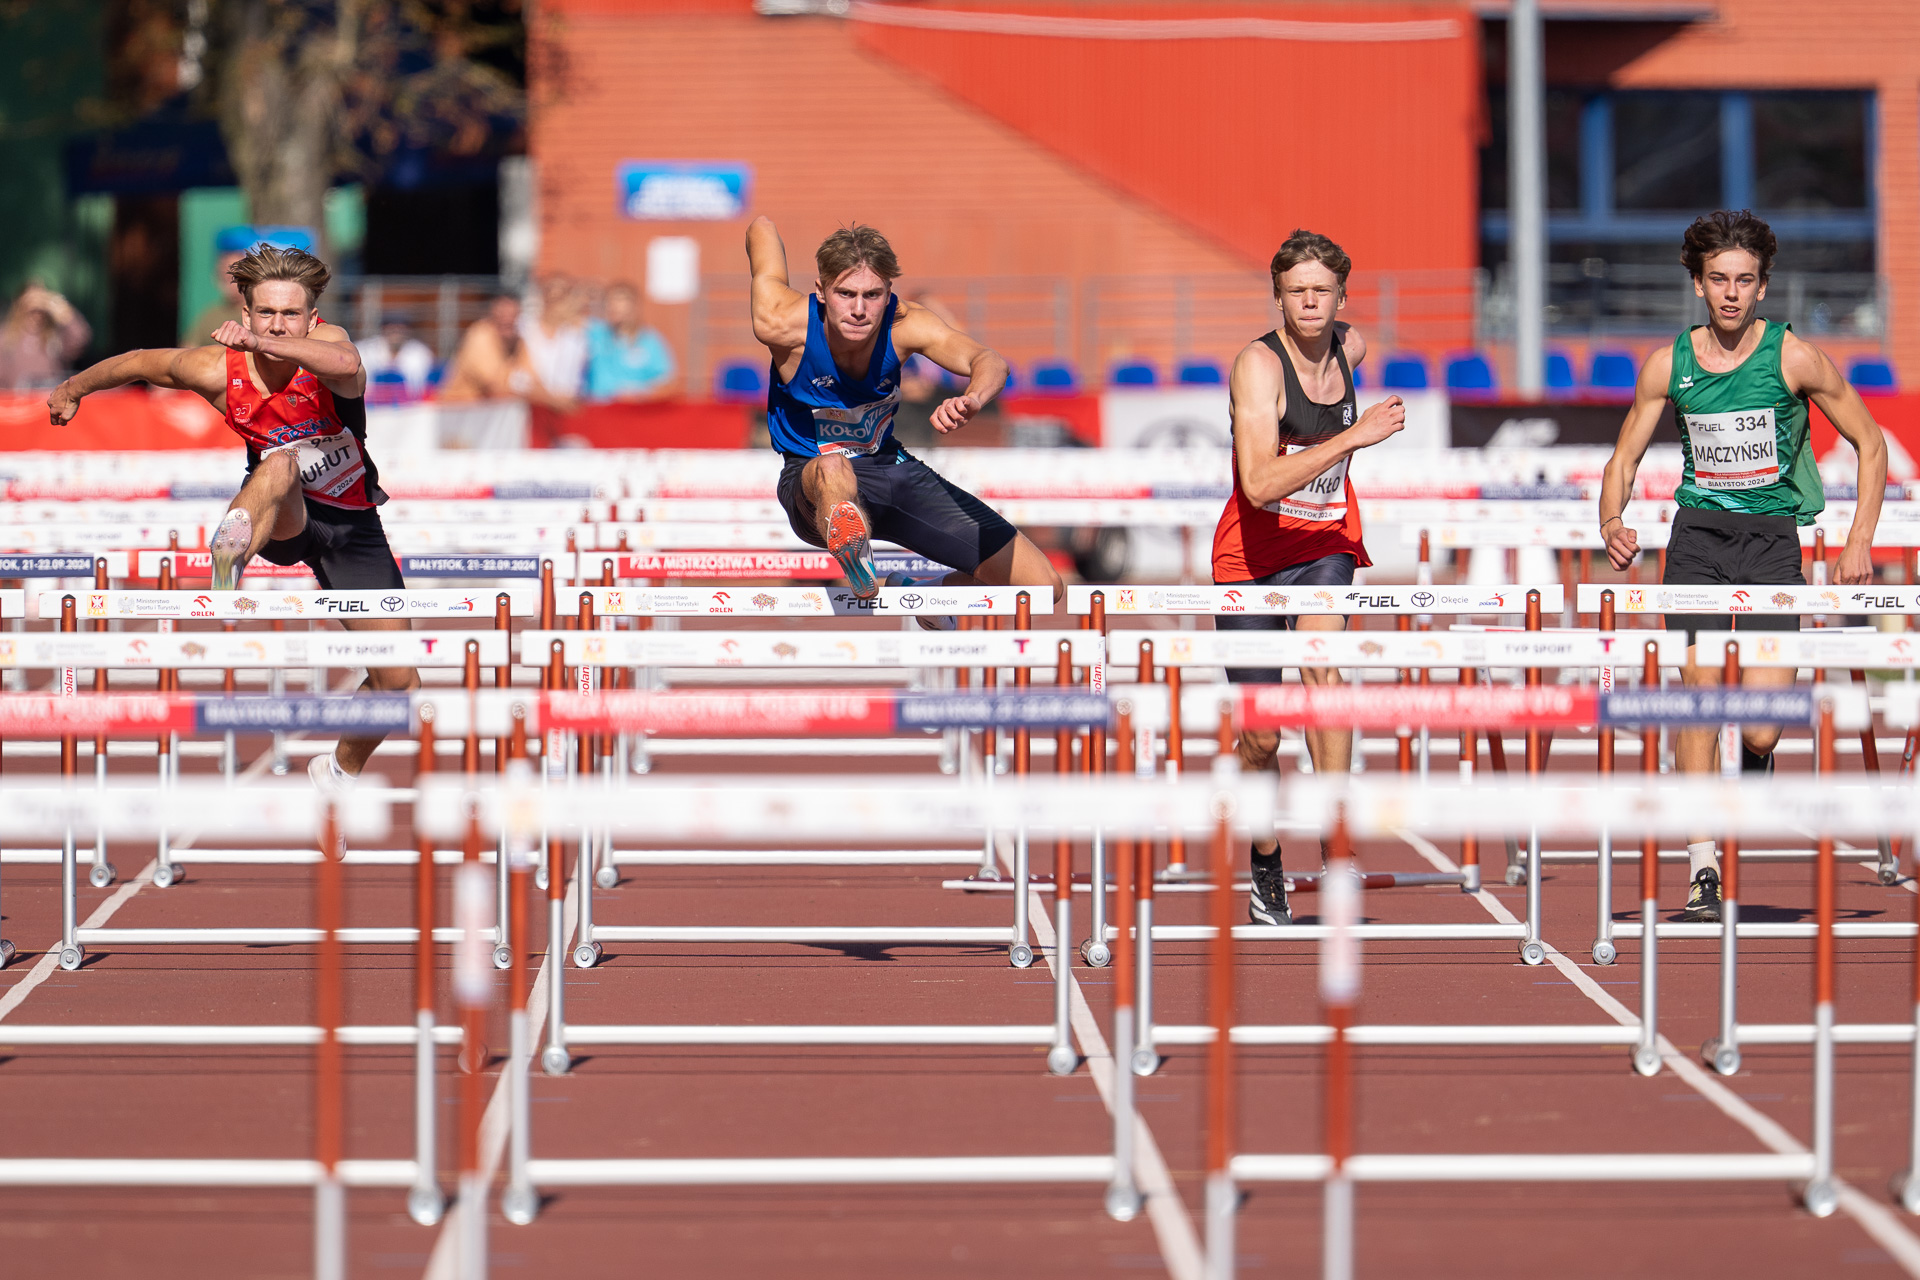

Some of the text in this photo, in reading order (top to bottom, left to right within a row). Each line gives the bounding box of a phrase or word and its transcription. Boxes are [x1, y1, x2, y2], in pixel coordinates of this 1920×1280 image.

[1698, 423, 1725, 432] FUEL
[1735, 415, 1767, 432] 334
[1694, 441, 1774, 466] MĄCZYŃSKI
[337, 477, 354, 491] 2024
[1747, 478, 1765, 486] 2024
[1278, 506, 1318, 518] BIAŁYSTOK
[756, 557, 802, 570] POLSKI
[803, 557, 829, 570] U16
[410, 600, 438, 610] Okęcie
[930, 598, 958, 606] Okęcie
[1358, 596, 1400, 608] FUEL
[1440, 596, 1469, 604] Okęcie
[1864, 596, 1905, 608] FUEL
[157, 604, 181, 612] Turystyki
[328, 601, 370, 612] FUEL
